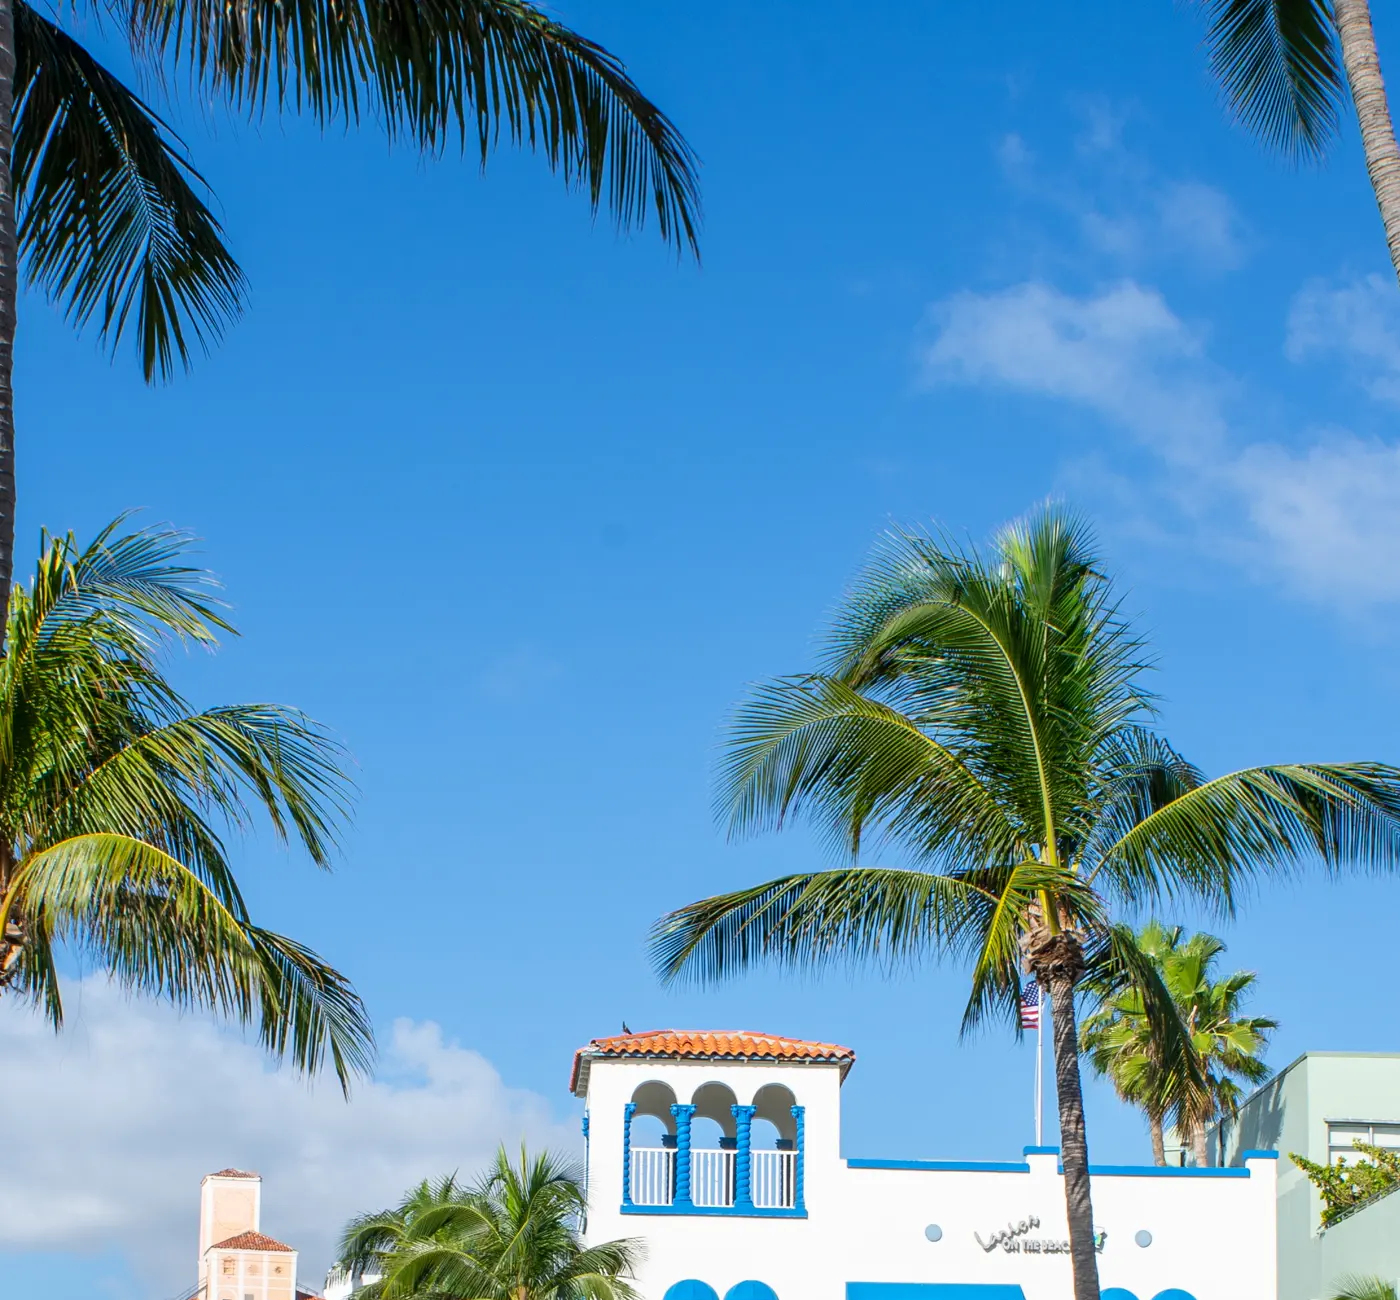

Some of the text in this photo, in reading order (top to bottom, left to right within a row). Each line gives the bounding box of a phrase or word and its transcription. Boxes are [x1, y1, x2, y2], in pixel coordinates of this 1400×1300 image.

[1002, 1239, 1070, 1252] ON THE BEAC
